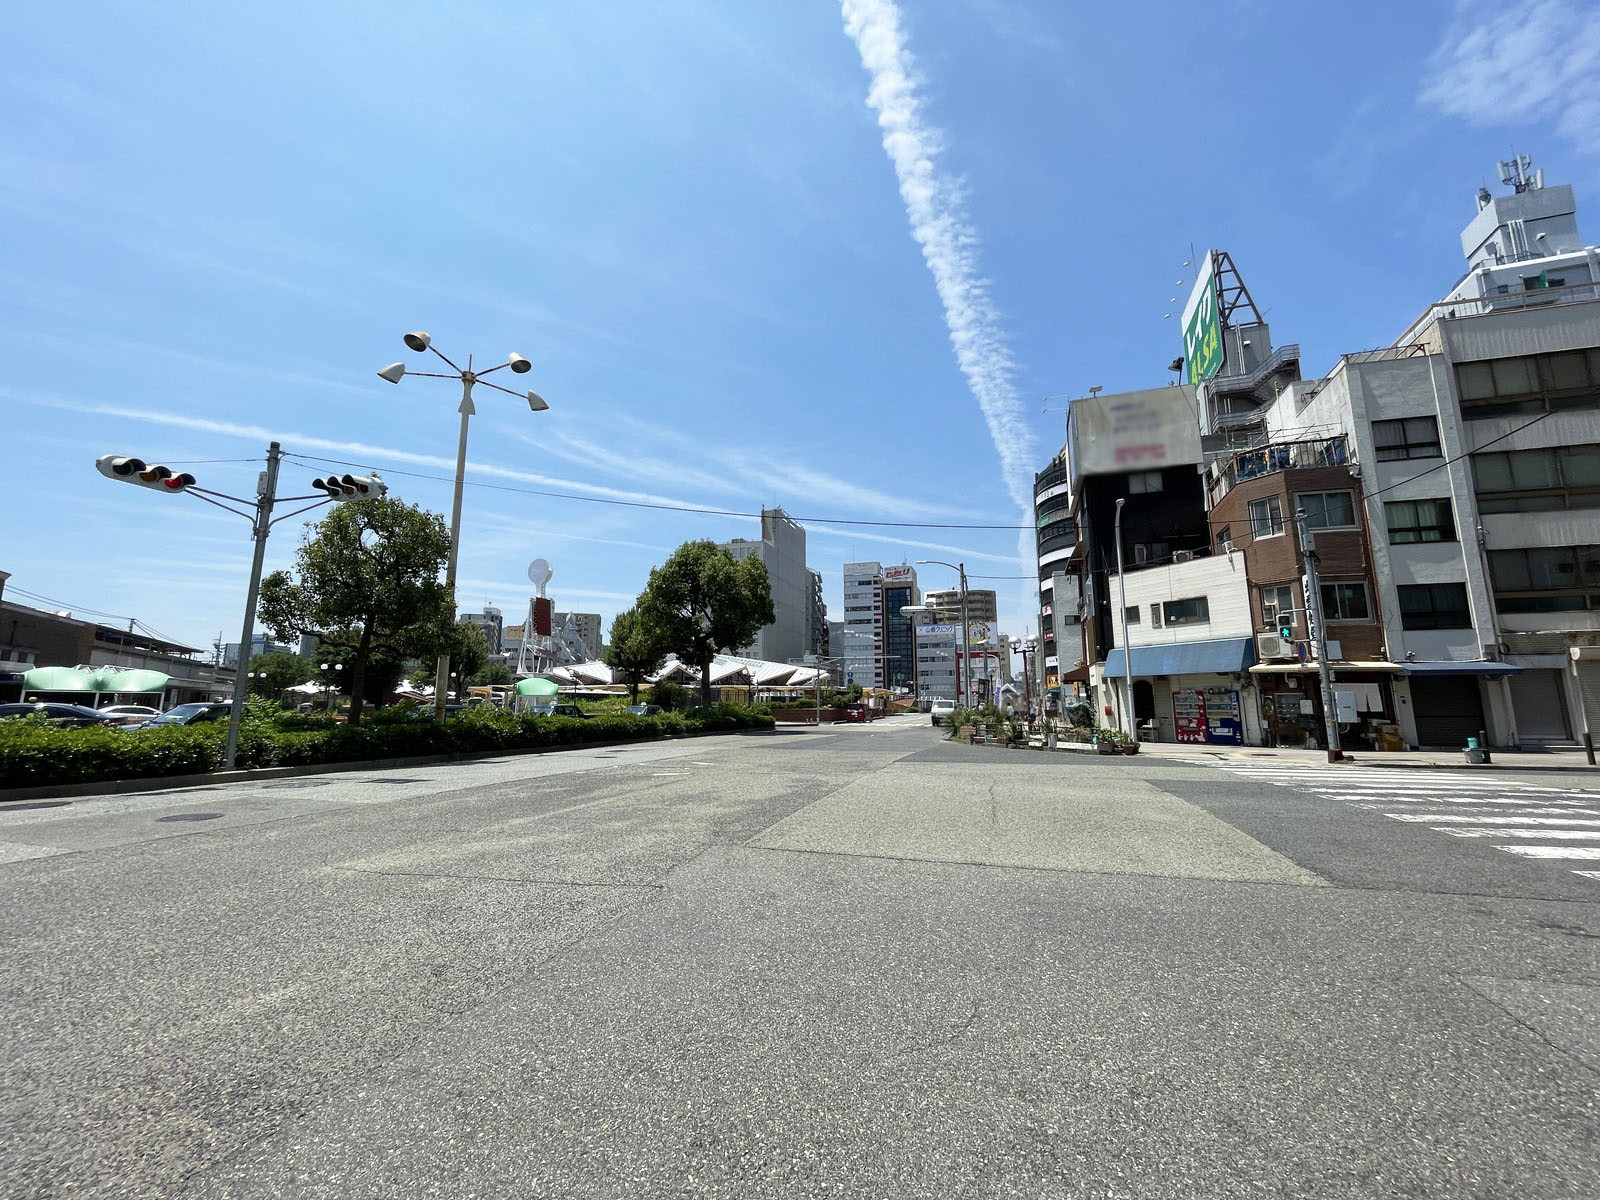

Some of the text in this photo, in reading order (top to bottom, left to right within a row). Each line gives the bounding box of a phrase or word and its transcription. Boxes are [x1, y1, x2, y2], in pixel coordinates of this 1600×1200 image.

[1187, 285, 1211, 361] レイク
[1192, 321, 1218, 385] ALSA
